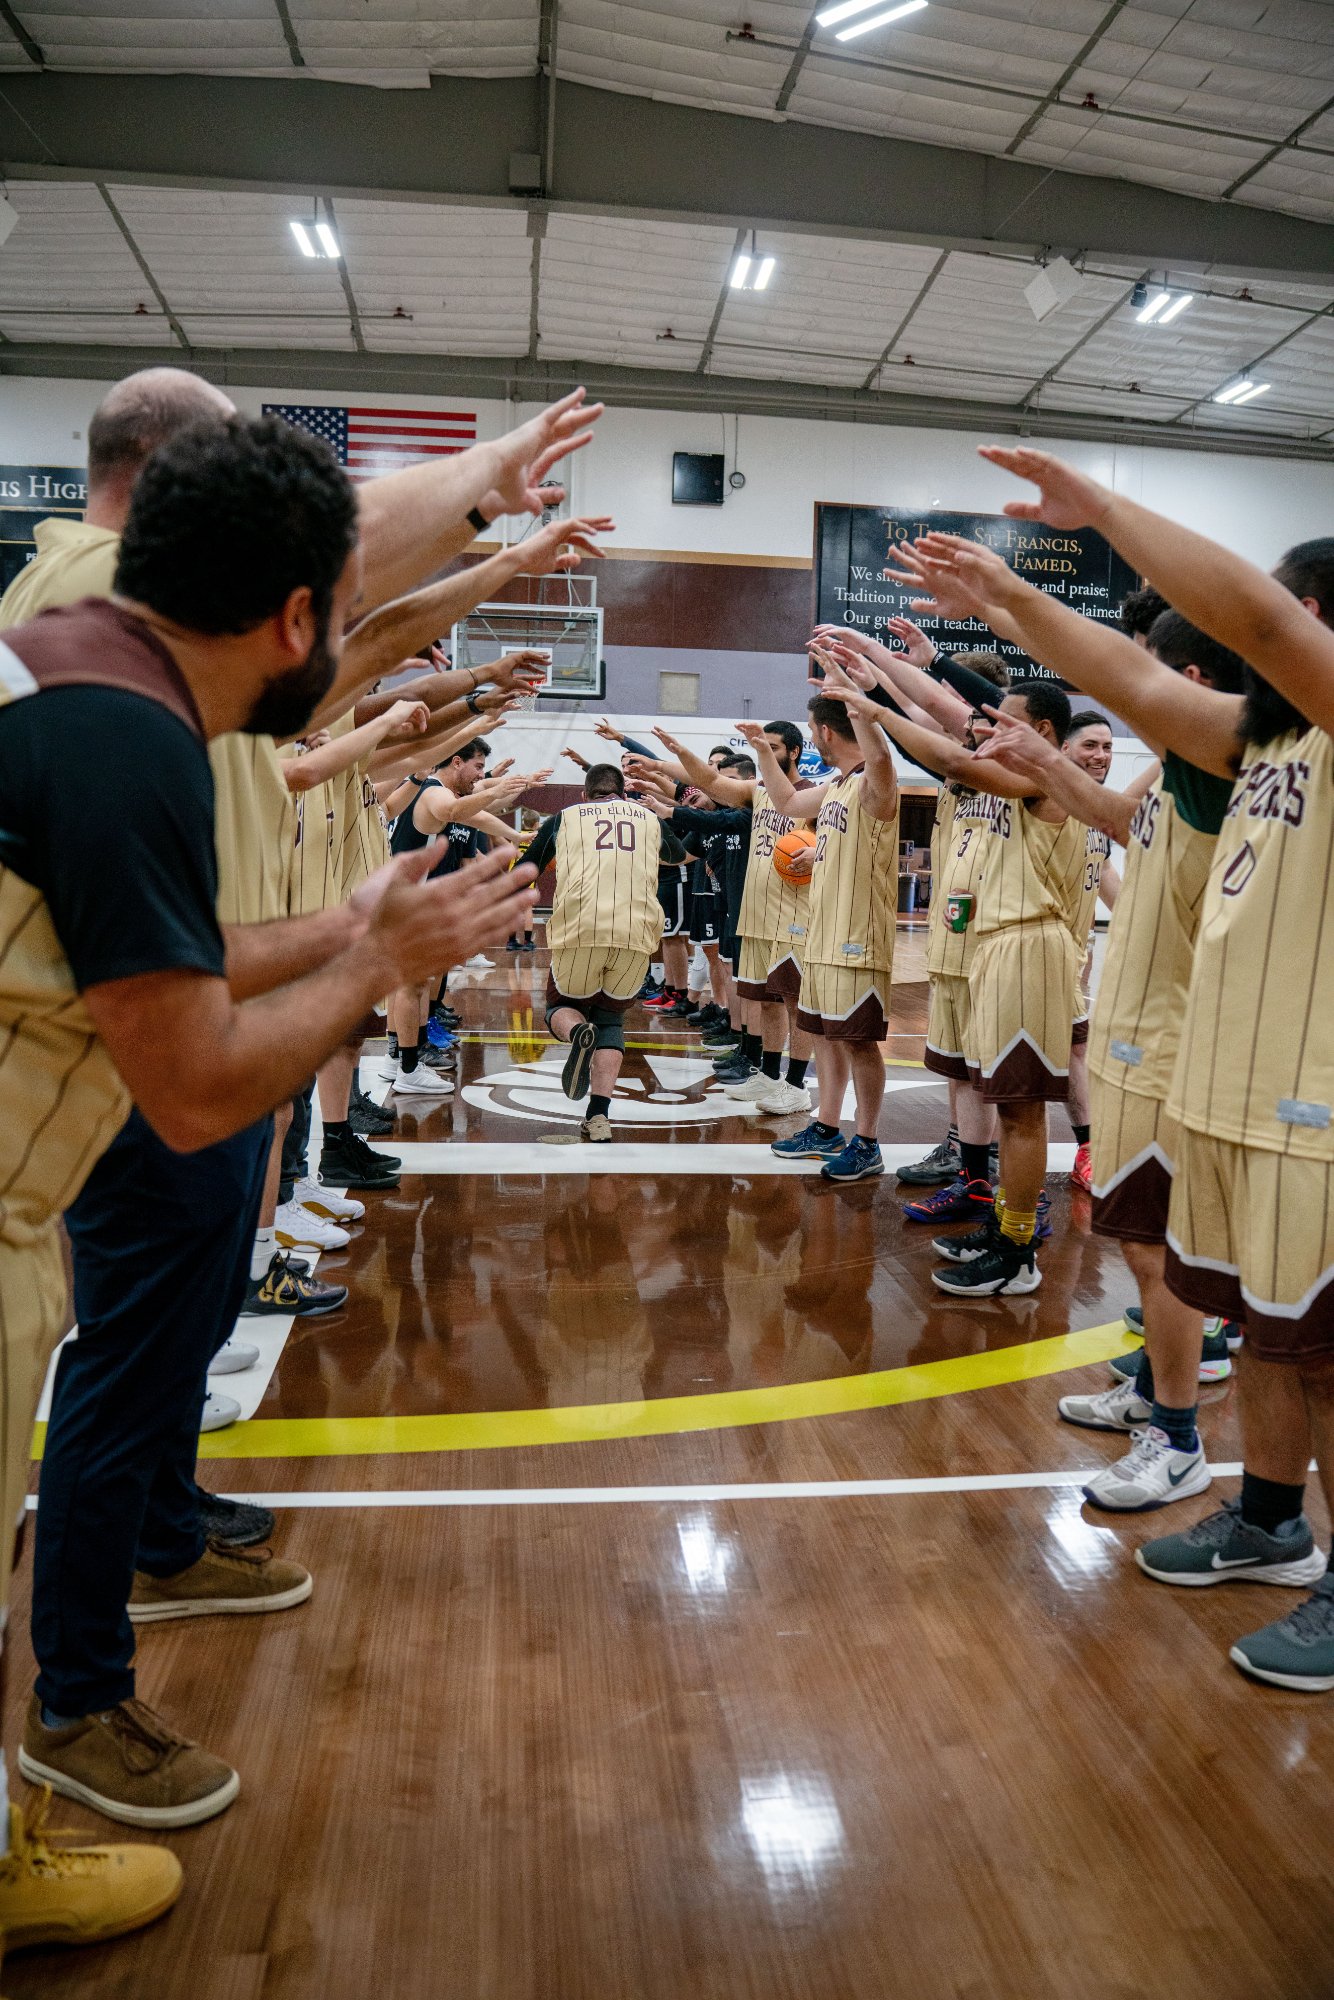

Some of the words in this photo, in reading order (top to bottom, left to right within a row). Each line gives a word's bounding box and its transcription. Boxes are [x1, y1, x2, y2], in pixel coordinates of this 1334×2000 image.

[850, 566, 873, 581] We
[1041, 580, 1065, 594] and
[1069, 583, 1109, 599] praise;
[834, 586, 895, 604] Tradition
[843, 609, 870, 624] Our
[915, 614, 939, 629] and
[888, 635, 907, 652] joy
[932, 634, 969, 652] hearts
[973, 637, 997, 654] and
[1001, 643, 1031, 656] voic
[1006, 667, 1025, 677] ma
[729, 737, 748, 747] CIF
[579, 807, 602, 817] BRO
[608, 806, 646, 820] ELIJAH
[594, 819, 636, 852] 20
[755, 834, 773, 857] 25
[957, 828, 973, 858] 3
[705, 923, 714, 937] 5
